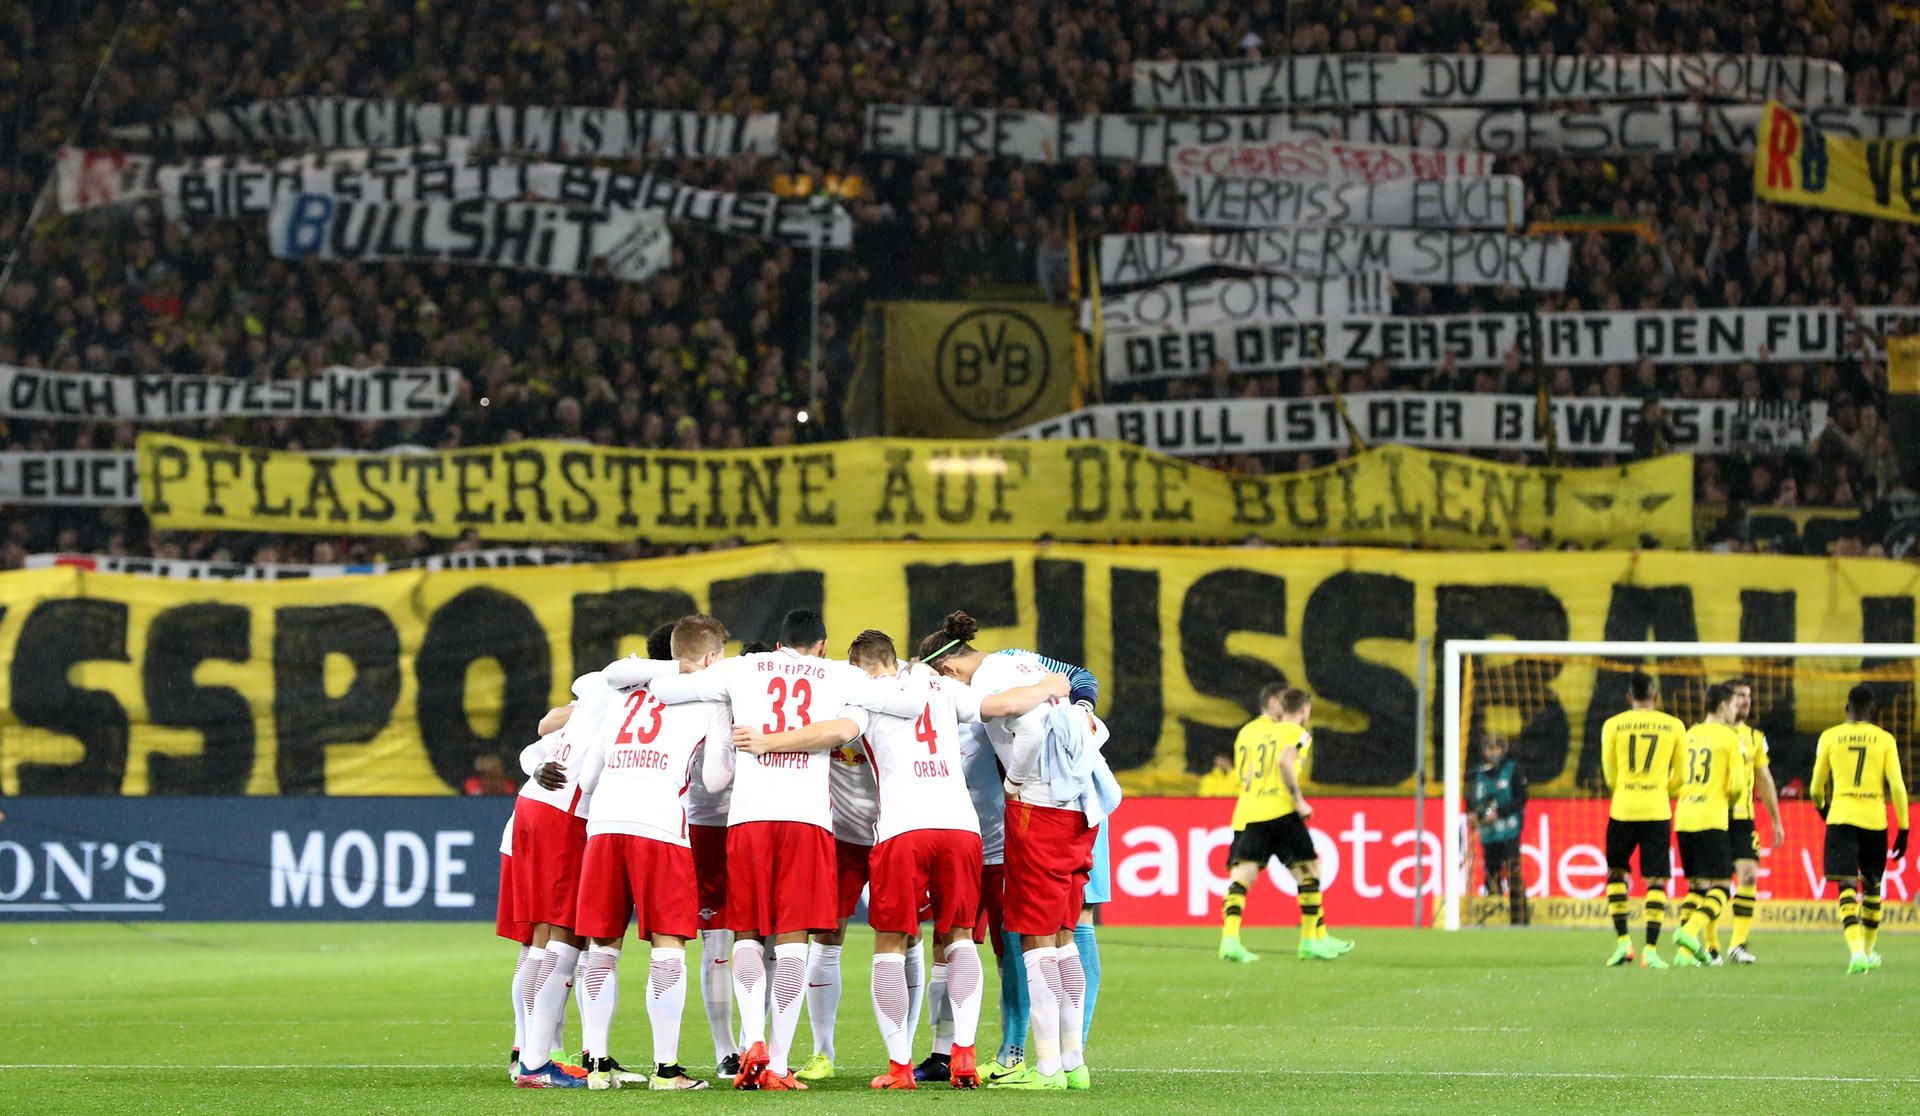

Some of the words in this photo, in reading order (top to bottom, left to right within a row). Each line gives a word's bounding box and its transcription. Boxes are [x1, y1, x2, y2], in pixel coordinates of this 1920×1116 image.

[1420, 58, 1482, 98] DU
[872, 103, 1022, 155] EURE
[1475, 103, 1920, 155] GESCHWST
[1767, 104, 1827, 192] RB
[1193, 175, 1377, 222] VERPISST
[1410, 178, 1509, 224] EUCH
[1115, 233, 1185, 282] AUS
[1412, 234, 1556, 292] SPORT
[955, 318, 1032, 388] BVB
[1125, 336, 1218, 376] DER
[1236, 324, 1326, 362] DFB
[1634, 314, 1744, 354] DEN
[1118, 407, 1242, 448] BULL
[1268, 404, 1341, 442] IST
[1368, 400, 1462, 440] DER
[147, 443, 836, 529] PFLASTERSTEINE
[874, 447, 1030, 525] AUF
[1066, 445, 1196, 524] DIE
[0, 572, 830, 796] SSPO
[762, 676, 812, 735] 33
[615, 690, 666, 745] 23
[915, 702, 938, 755] 4
[607, 749, 668, 771] LSTENBERG
[1628, 733, 1660, 774] 17
[1847, 745, 1867, 788] 7
[270, 830, 475, 908] MODE
